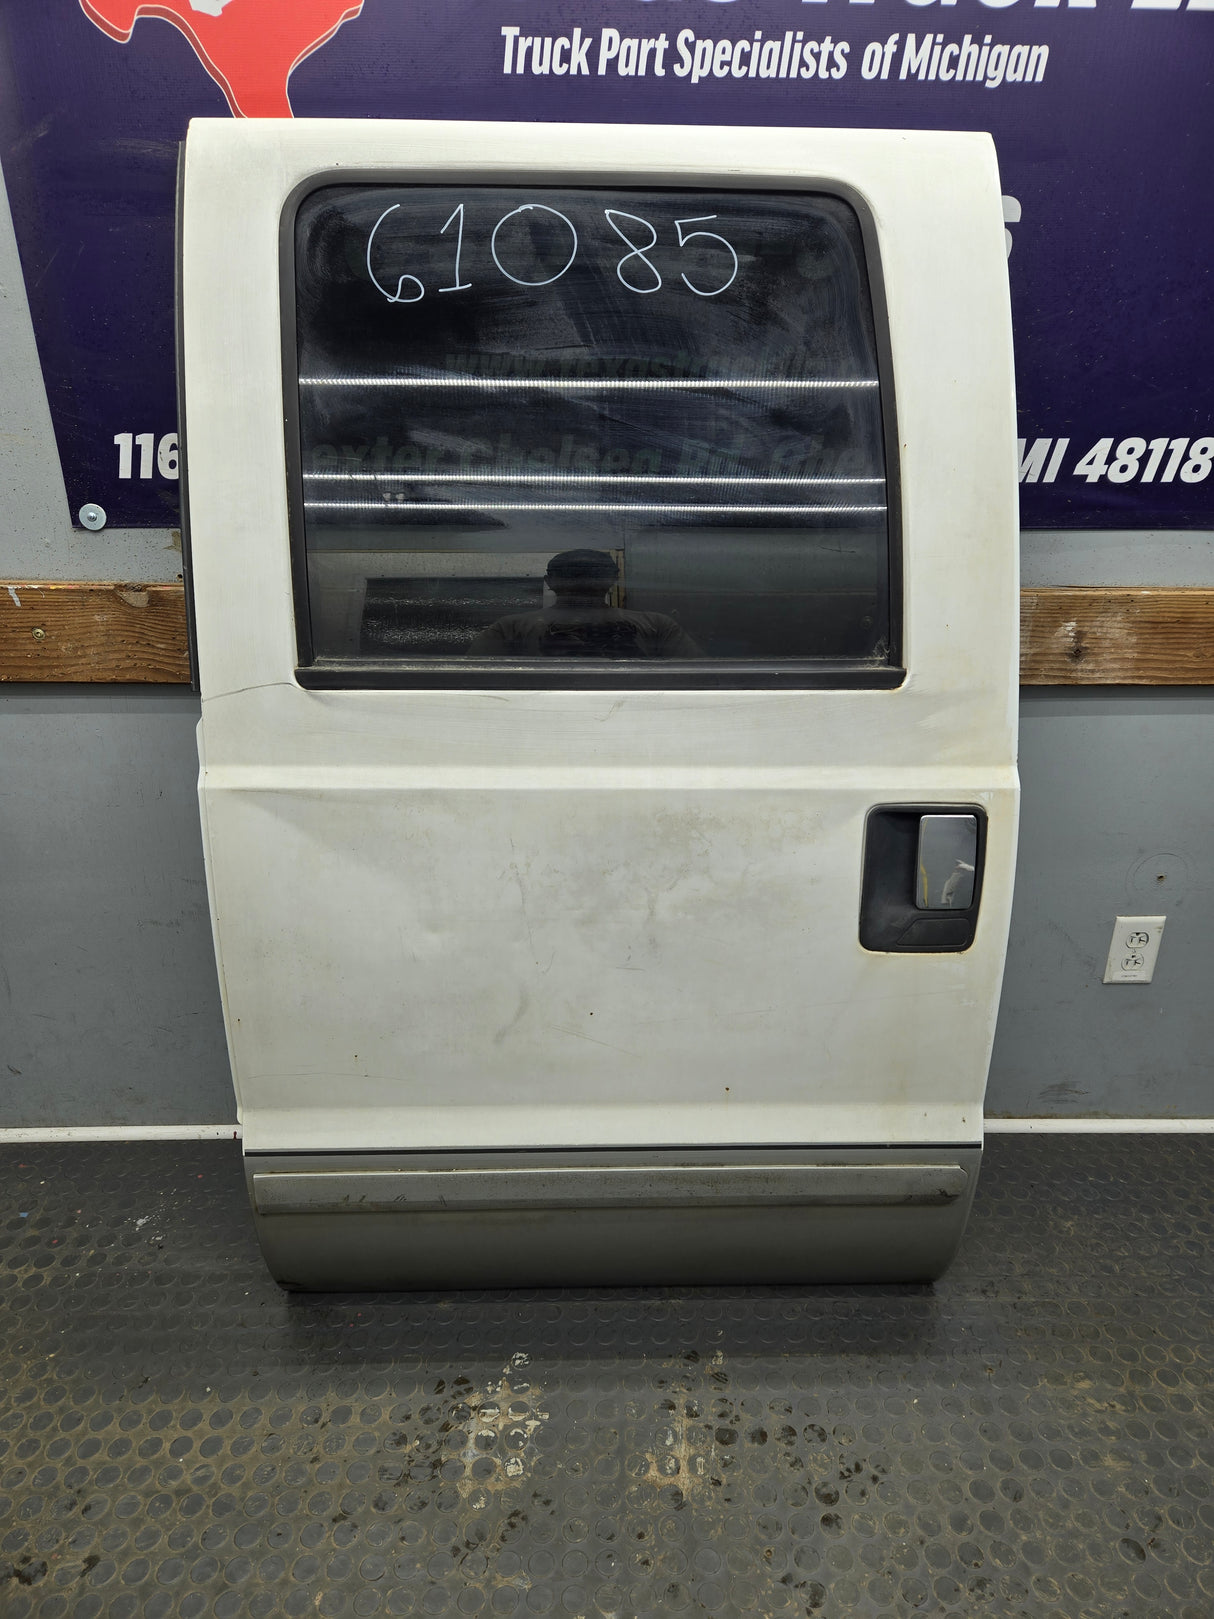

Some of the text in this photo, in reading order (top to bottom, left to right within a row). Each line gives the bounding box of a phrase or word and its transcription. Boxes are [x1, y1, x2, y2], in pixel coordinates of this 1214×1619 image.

[501, 26, 1050, 88] Truck Part Specialists of Michigan
[311, 435, 443, 479] exter
[1072, 436, 1214, 484] 48118
